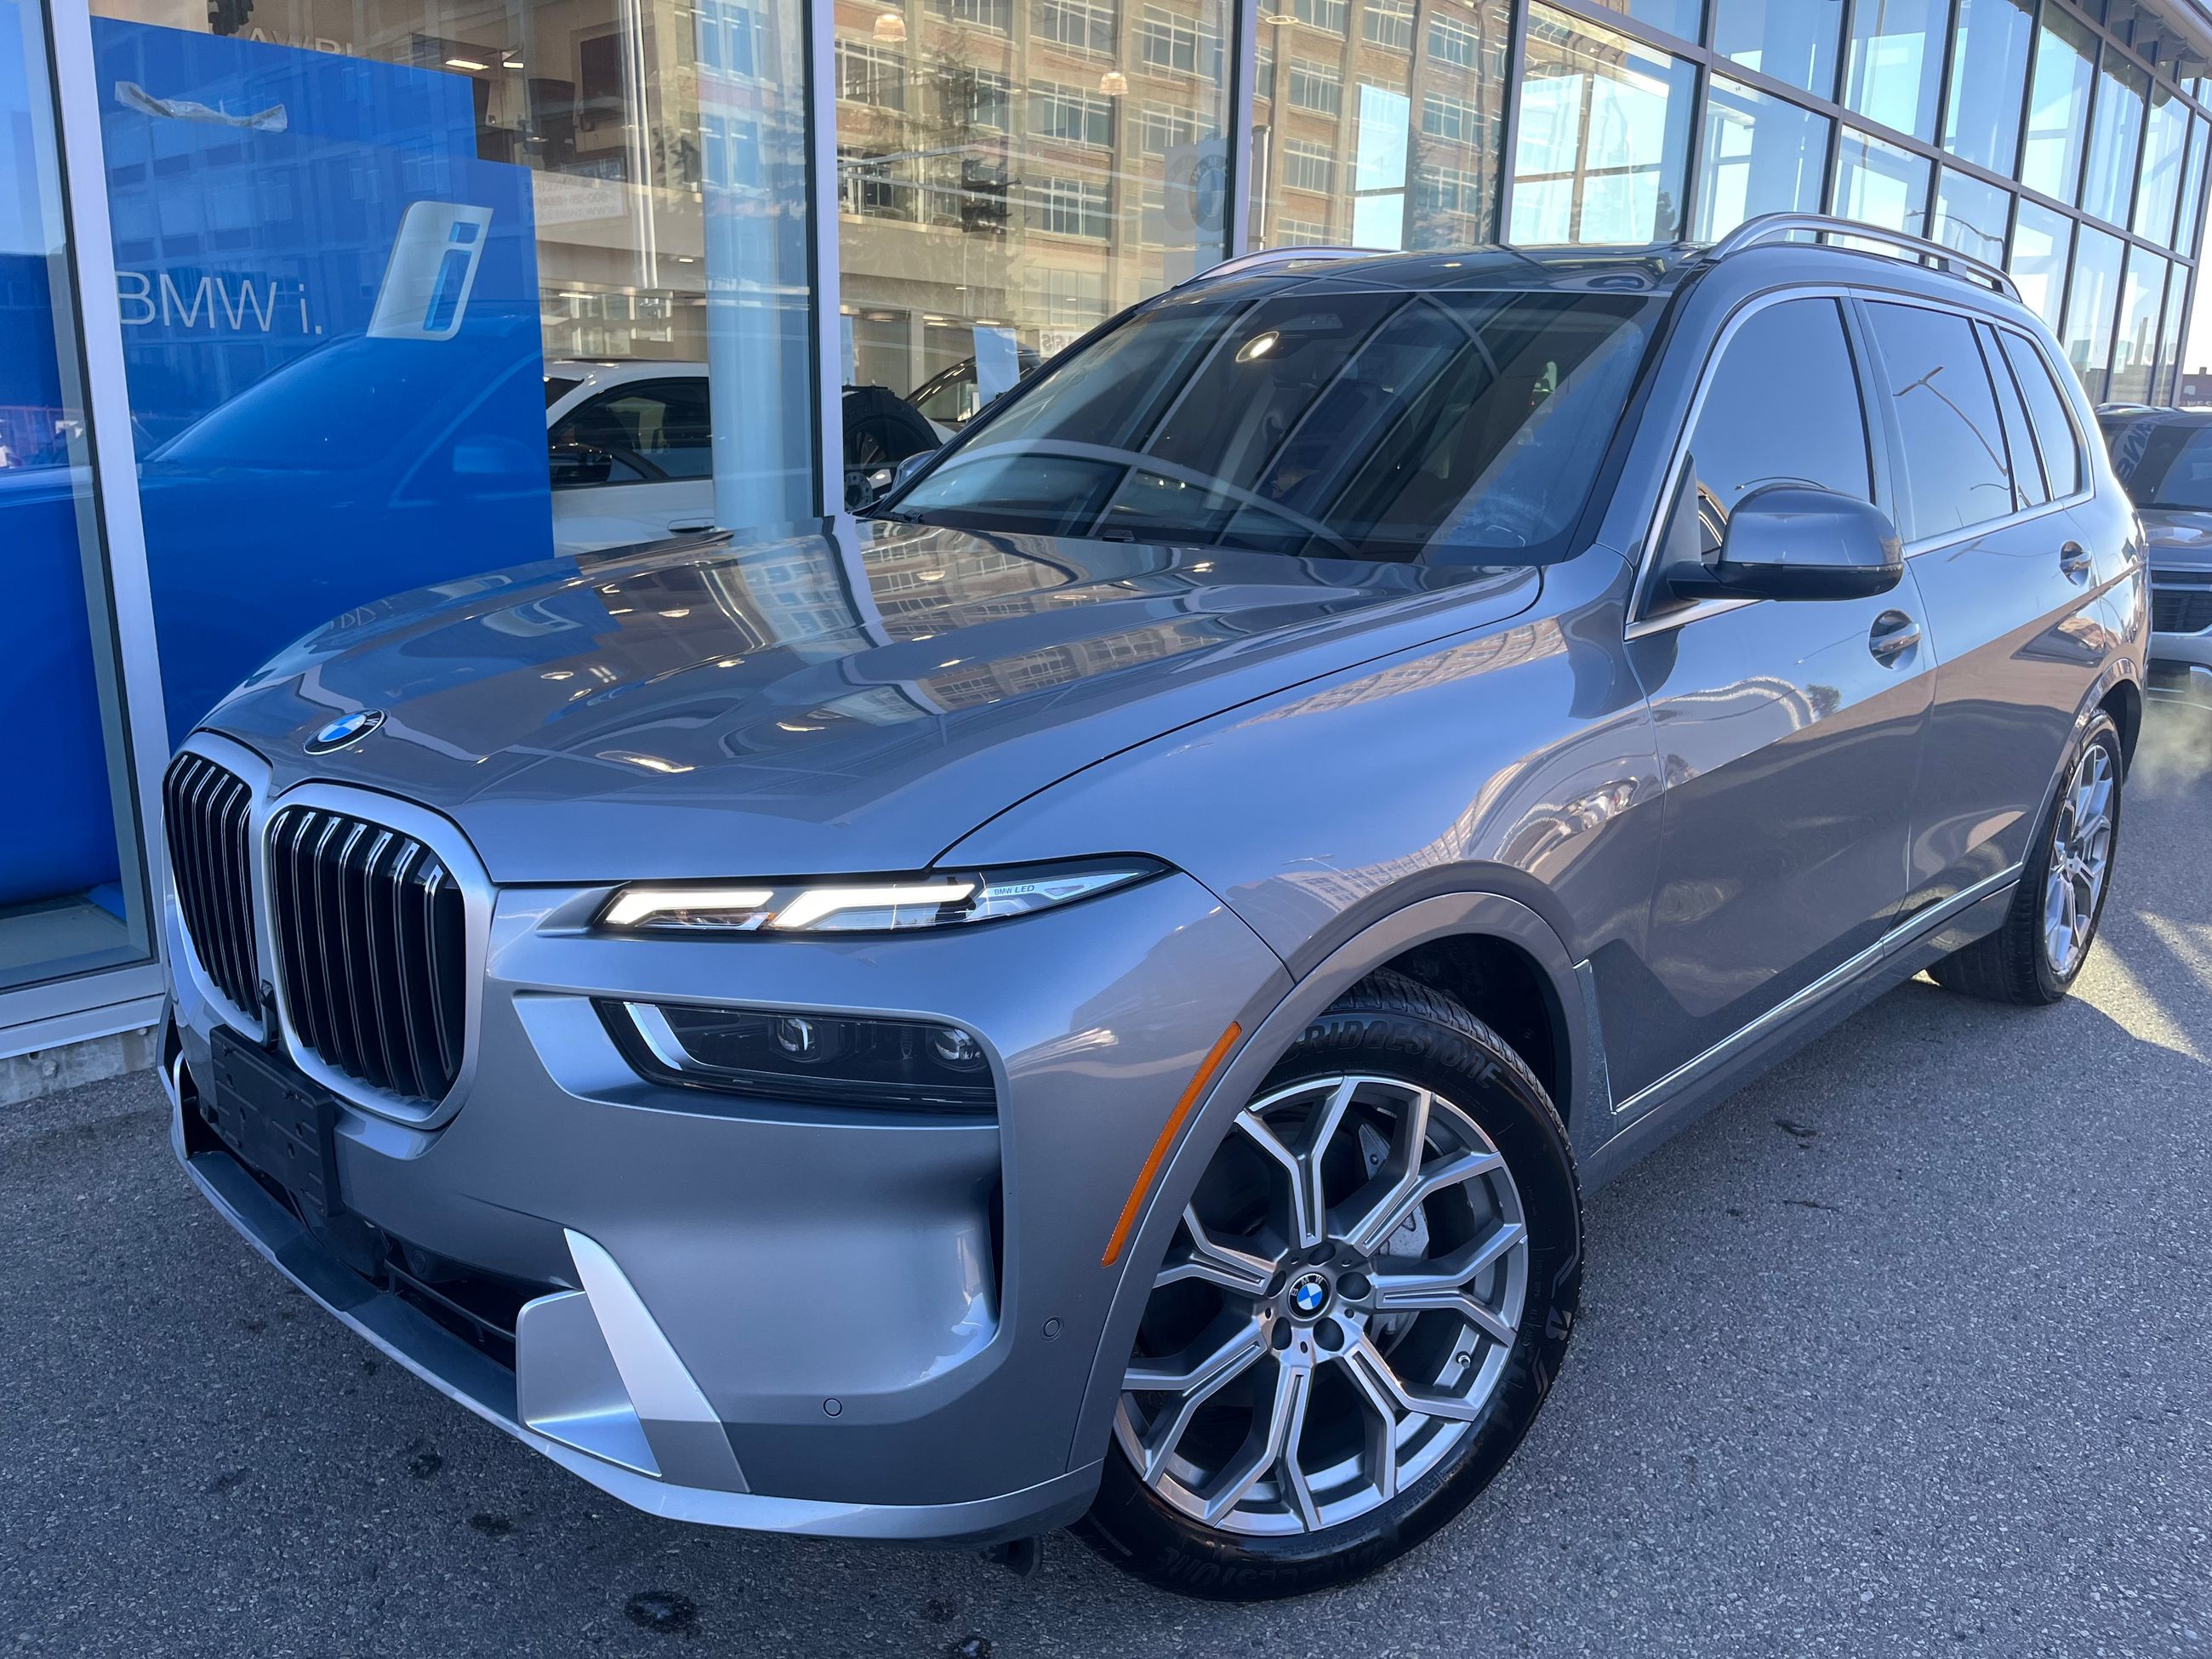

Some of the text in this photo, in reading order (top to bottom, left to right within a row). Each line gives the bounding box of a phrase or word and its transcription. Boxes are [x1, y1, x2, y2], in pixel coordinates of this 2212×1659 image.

[115, 271, 277, 333] BMW
[994, 885, 1035, 896] BMW LED
[1291, 1275, 1325, 1297] BMW
